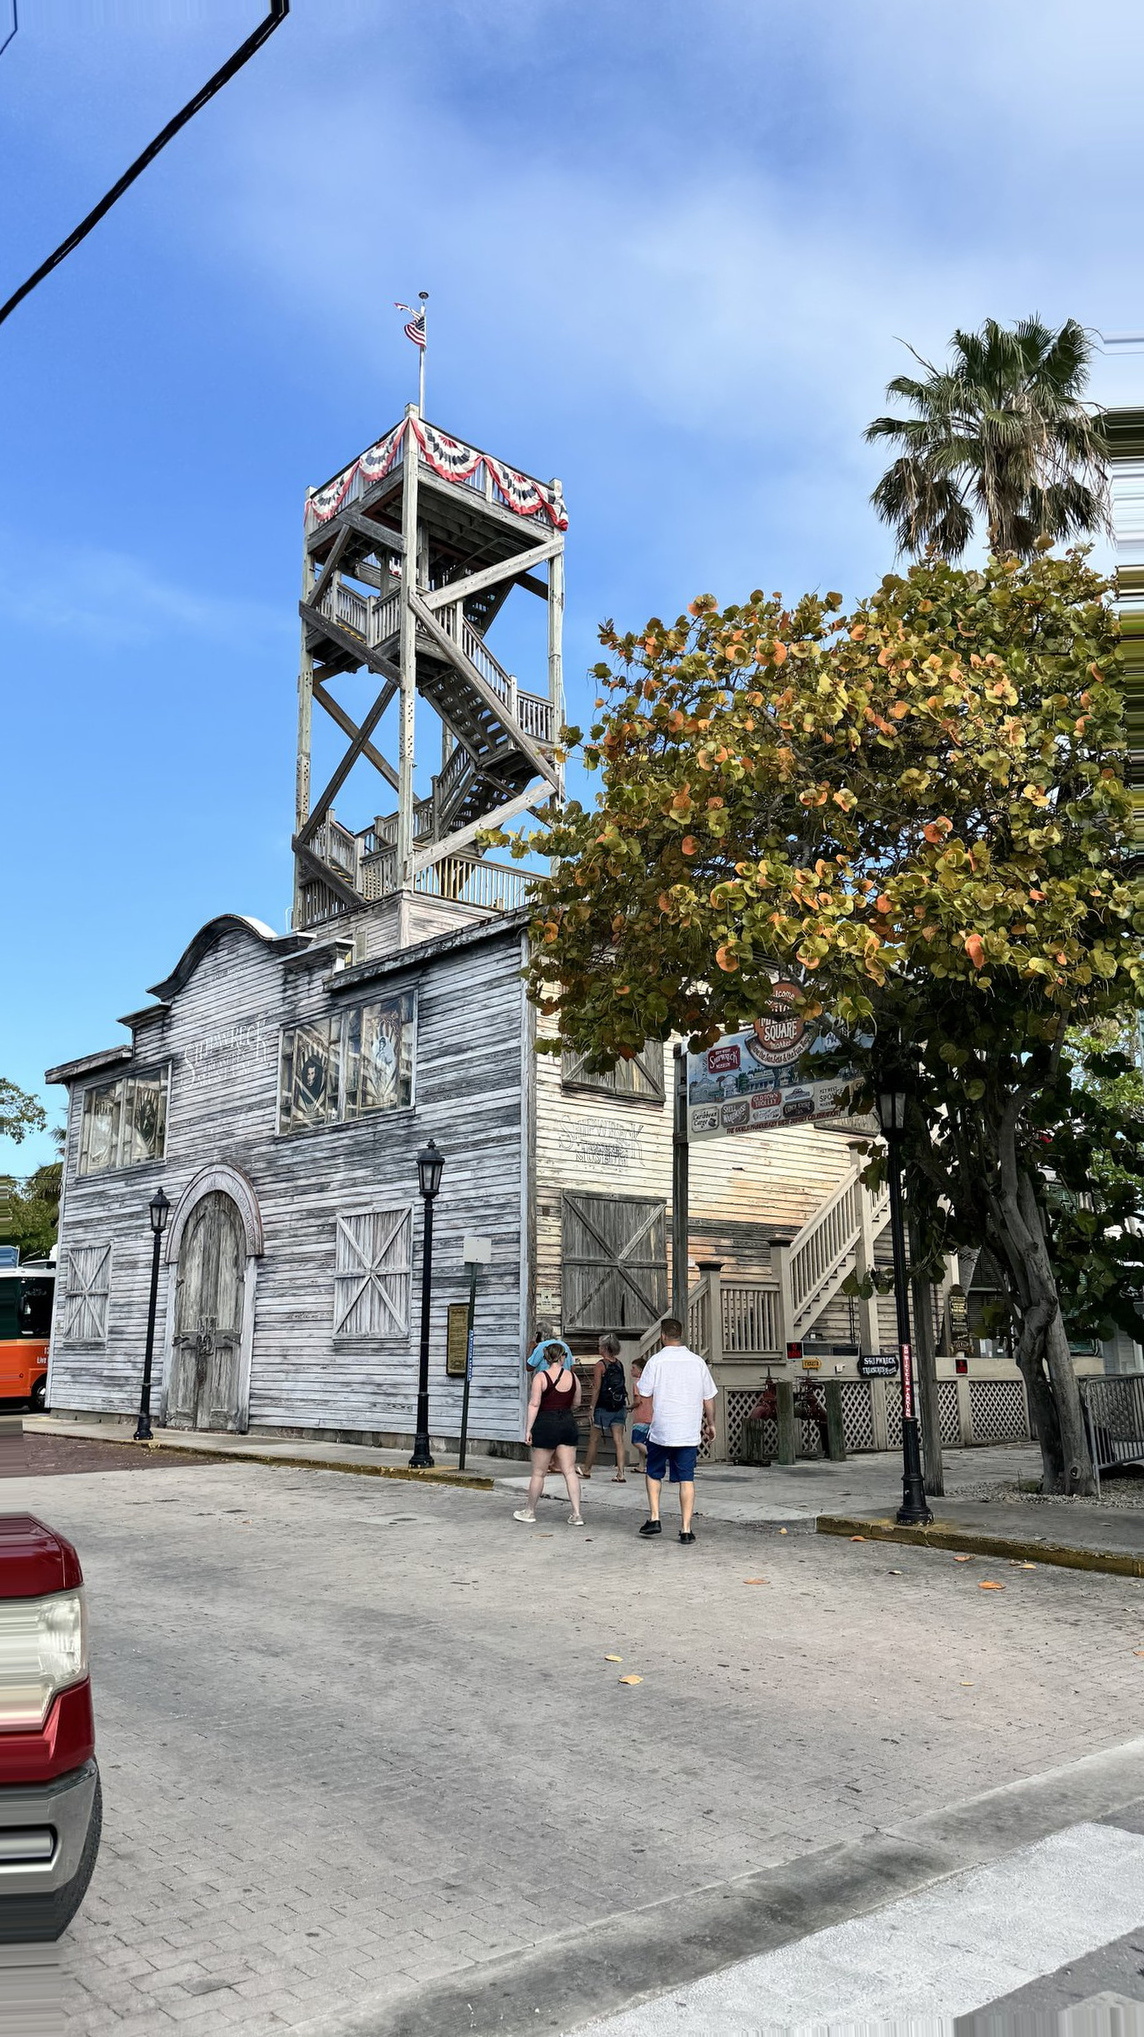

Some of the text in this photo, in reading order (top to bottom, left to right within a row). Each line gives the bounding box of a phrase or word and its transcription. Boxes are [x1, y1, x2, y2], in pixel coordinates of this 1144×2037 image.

[763, 1020, 797, 1042] SQUARE
[754, 1097, 777, 1108] TROLLEY
[863, 1356, 896, 1366] SHIPWRECK
